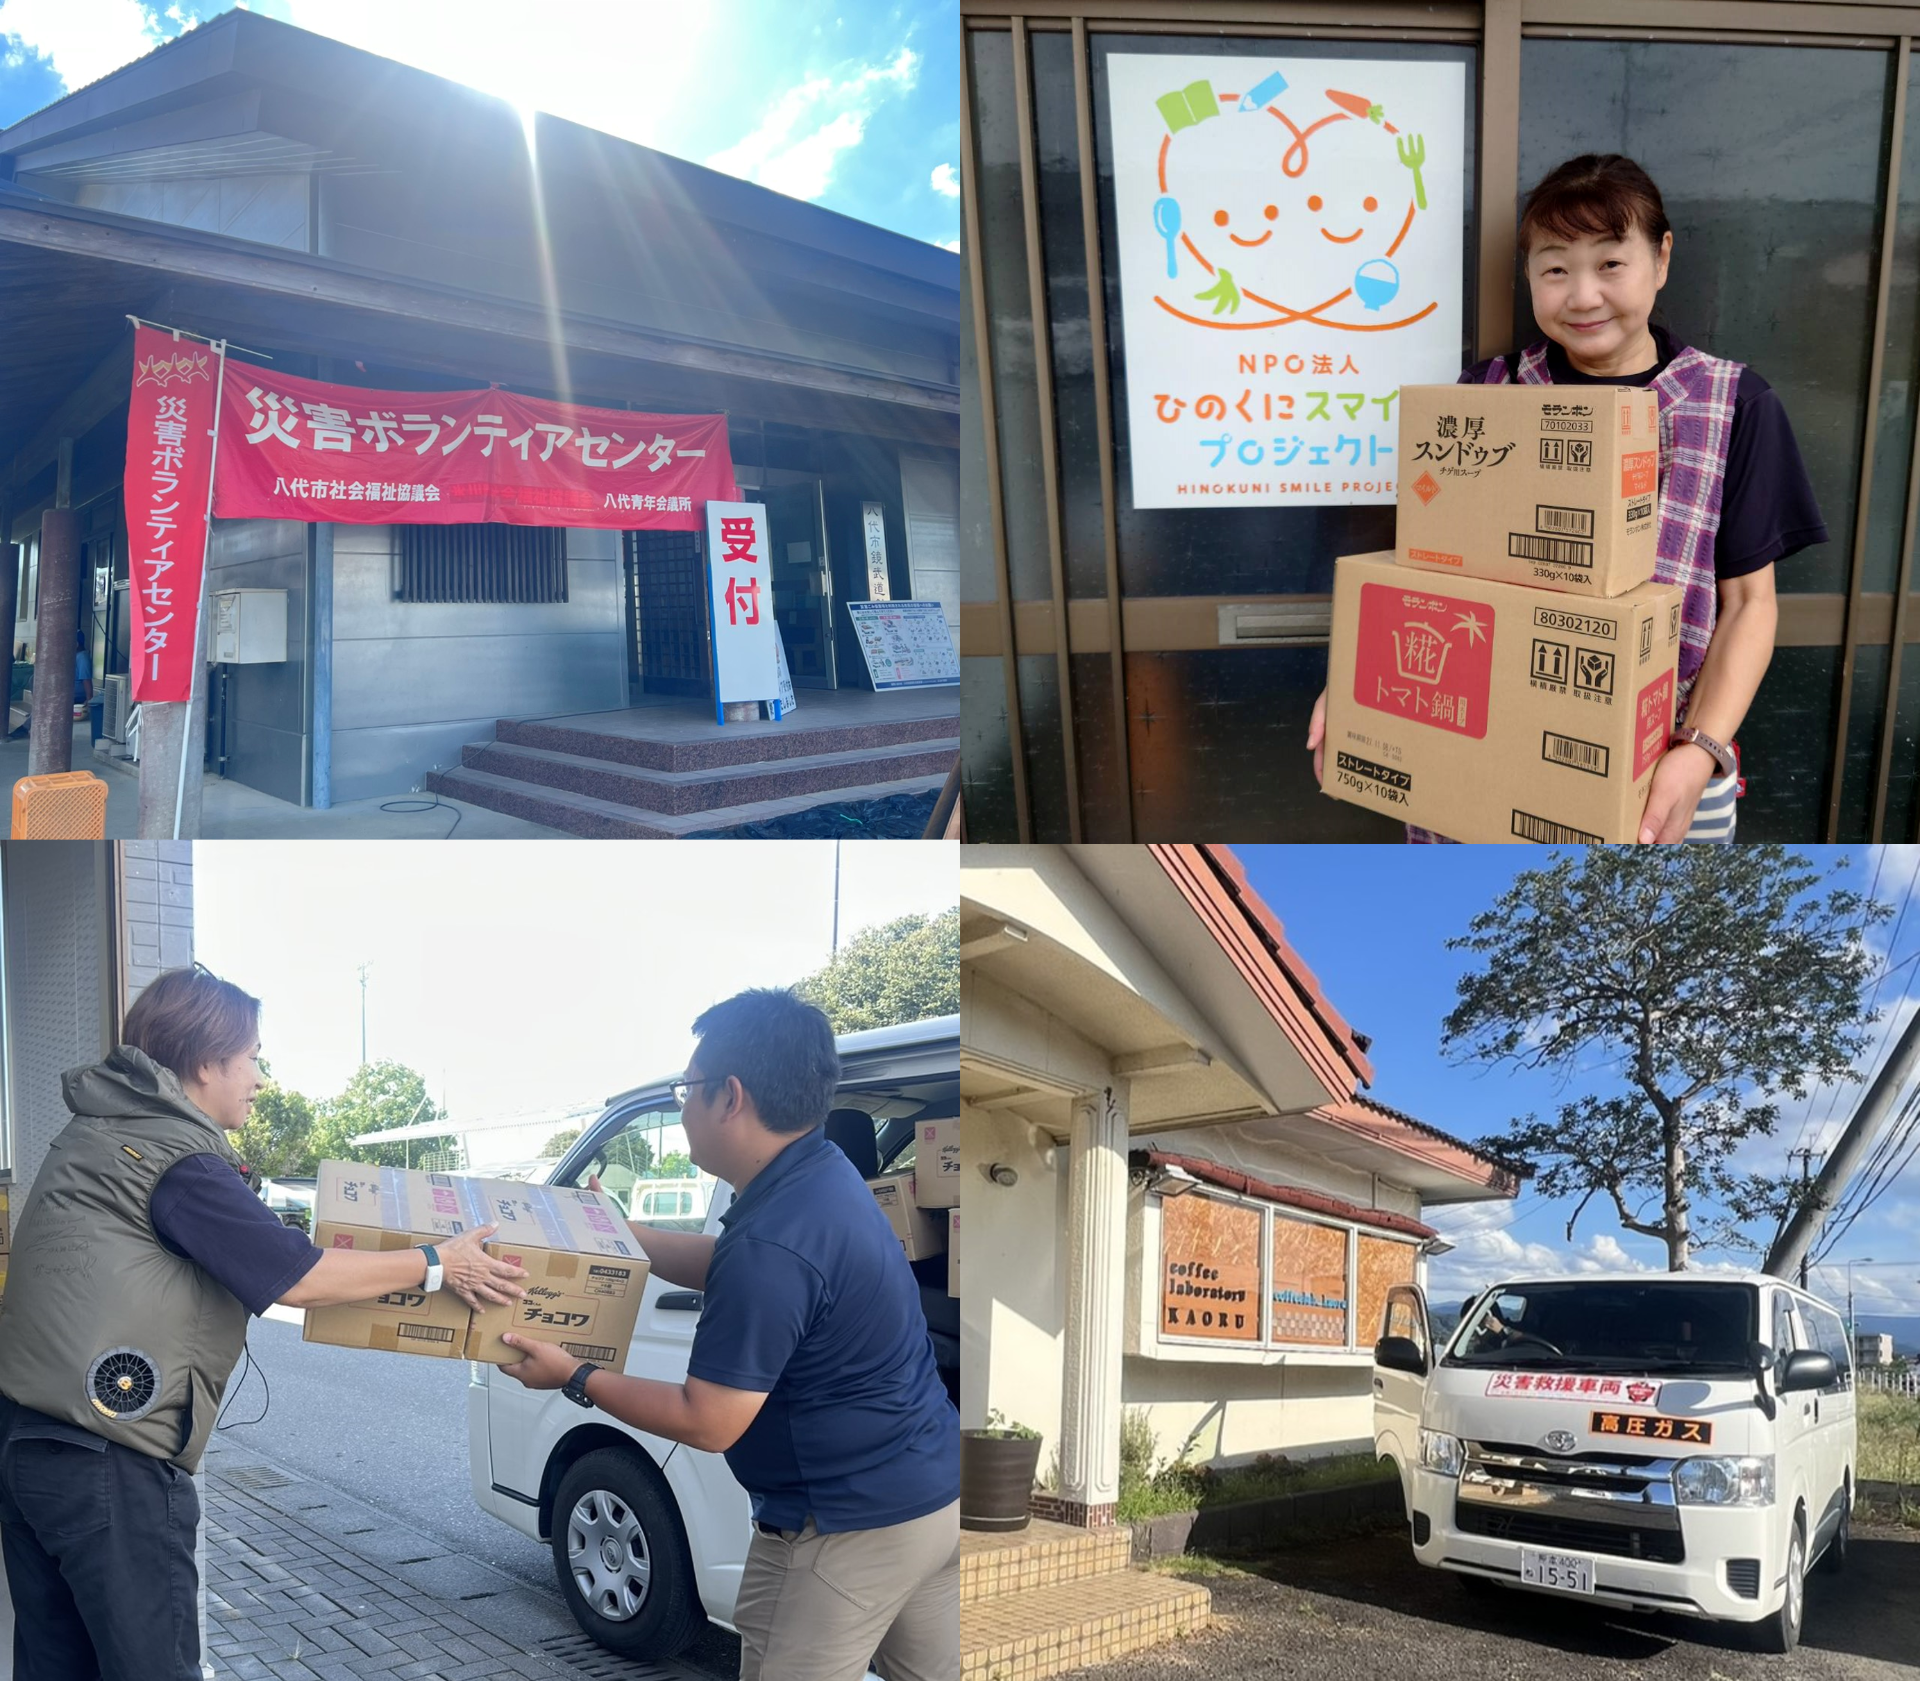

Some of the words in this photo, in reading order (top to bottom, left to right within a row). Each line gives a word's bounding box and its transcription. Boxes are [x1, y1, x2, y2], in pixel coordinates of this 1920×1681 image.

[1239, 354, 1360, 375] NPO法人
[1541, 404, 1594, 416] モランボン
[244, 386, 706, 473] 災害ボランティアセンター
[1436, 415, 1486, 440] 濃厚
[1544, 421, 1589, 431] 70102033
[1199, 433, 1394, 468] プロジェクト
[1411, 440, 1517, 468] スンドゥブ
[1439, 466, 1482, 478] チゲ用スープ
[273, 477, 441, 503] 八代市社会福祉協議会
[1177, 483, 1270, 495] HINOKUNI
[1280, 482, 1332, 493] SMILE
[604, 493, 692, 512] 八代青年会議所
[142, 394, 188, 681] 災害ボランティアセンター
[867, 507, 886, 601] 八代市鏡武道
[1411, 550, 1462, 565] ストレートタイプ
[720, 516, 761, 626] 受付
[1402, 595, 1448, 613] モランボン
[1540, 611, 1611, 636] 80302120
[1404, 630, 1438, 675] 糀
[1376, 675, 1455, 723] トマト鍋
[1530, 680, 1567, 694] 横積厳禁
[1573, 689, 1613, 705] 取扱注意
[1338, 754, 1411, 788] ストレートタイプ
[1336, 771, 1410, 806] 750g×10袋入
[1169, 1261, 1219, 1281] coffee
[376, 1293, 426, 1307] ョコワ
[527, 1286, 562, 1299] Kellogg's
[1169, 1278, 1246, 1303] laboratory
[524, 1308, 590, 1327] チョコワ
[1168, 1307, 1245, 1329] KAORU
[1492, 1374, 1623, 1396] 災害救援車両
[1601, 1415, 1702, 1441] 高圧ガス
[1540, 1565, 1587, 1591] 15-51
